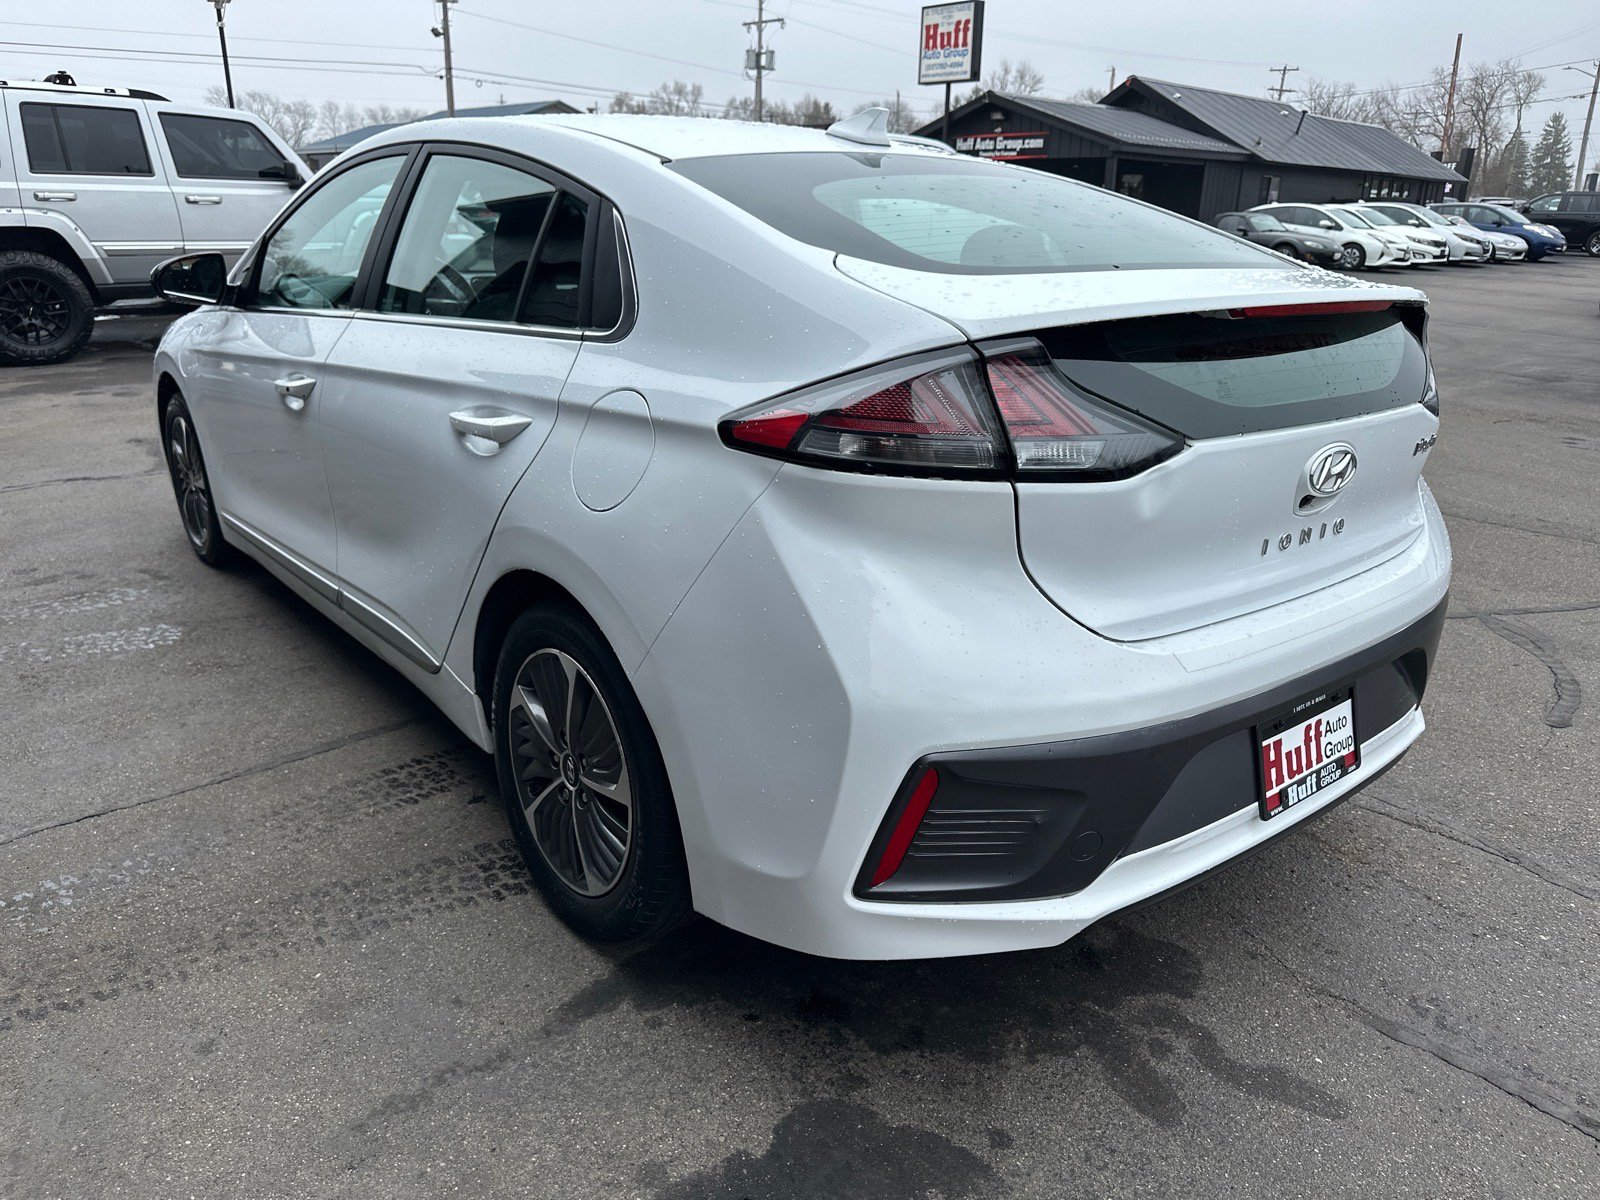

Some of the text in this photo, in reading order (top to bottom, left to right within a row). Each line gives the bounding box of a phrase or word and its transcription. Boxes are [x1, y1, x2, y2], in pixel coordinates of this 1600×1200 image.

[924, 18, 971, 51] Huff
[922, 47, 969, 60] Auto Group
[956, 136, 1044, 151] Huff Auto Group.com
[1261, 517, 1345, 556] IONIQ
[1324, 714, 1348, 738] Auto
[1263, 718, 1323, 792] Huff
[1324, 734, 1354, 758] Group
[1320, 762, 1337, 778] AUTO
[1320, 770, 1342, 787] GROUP
[1287, 773, 1317, 807] Huff
